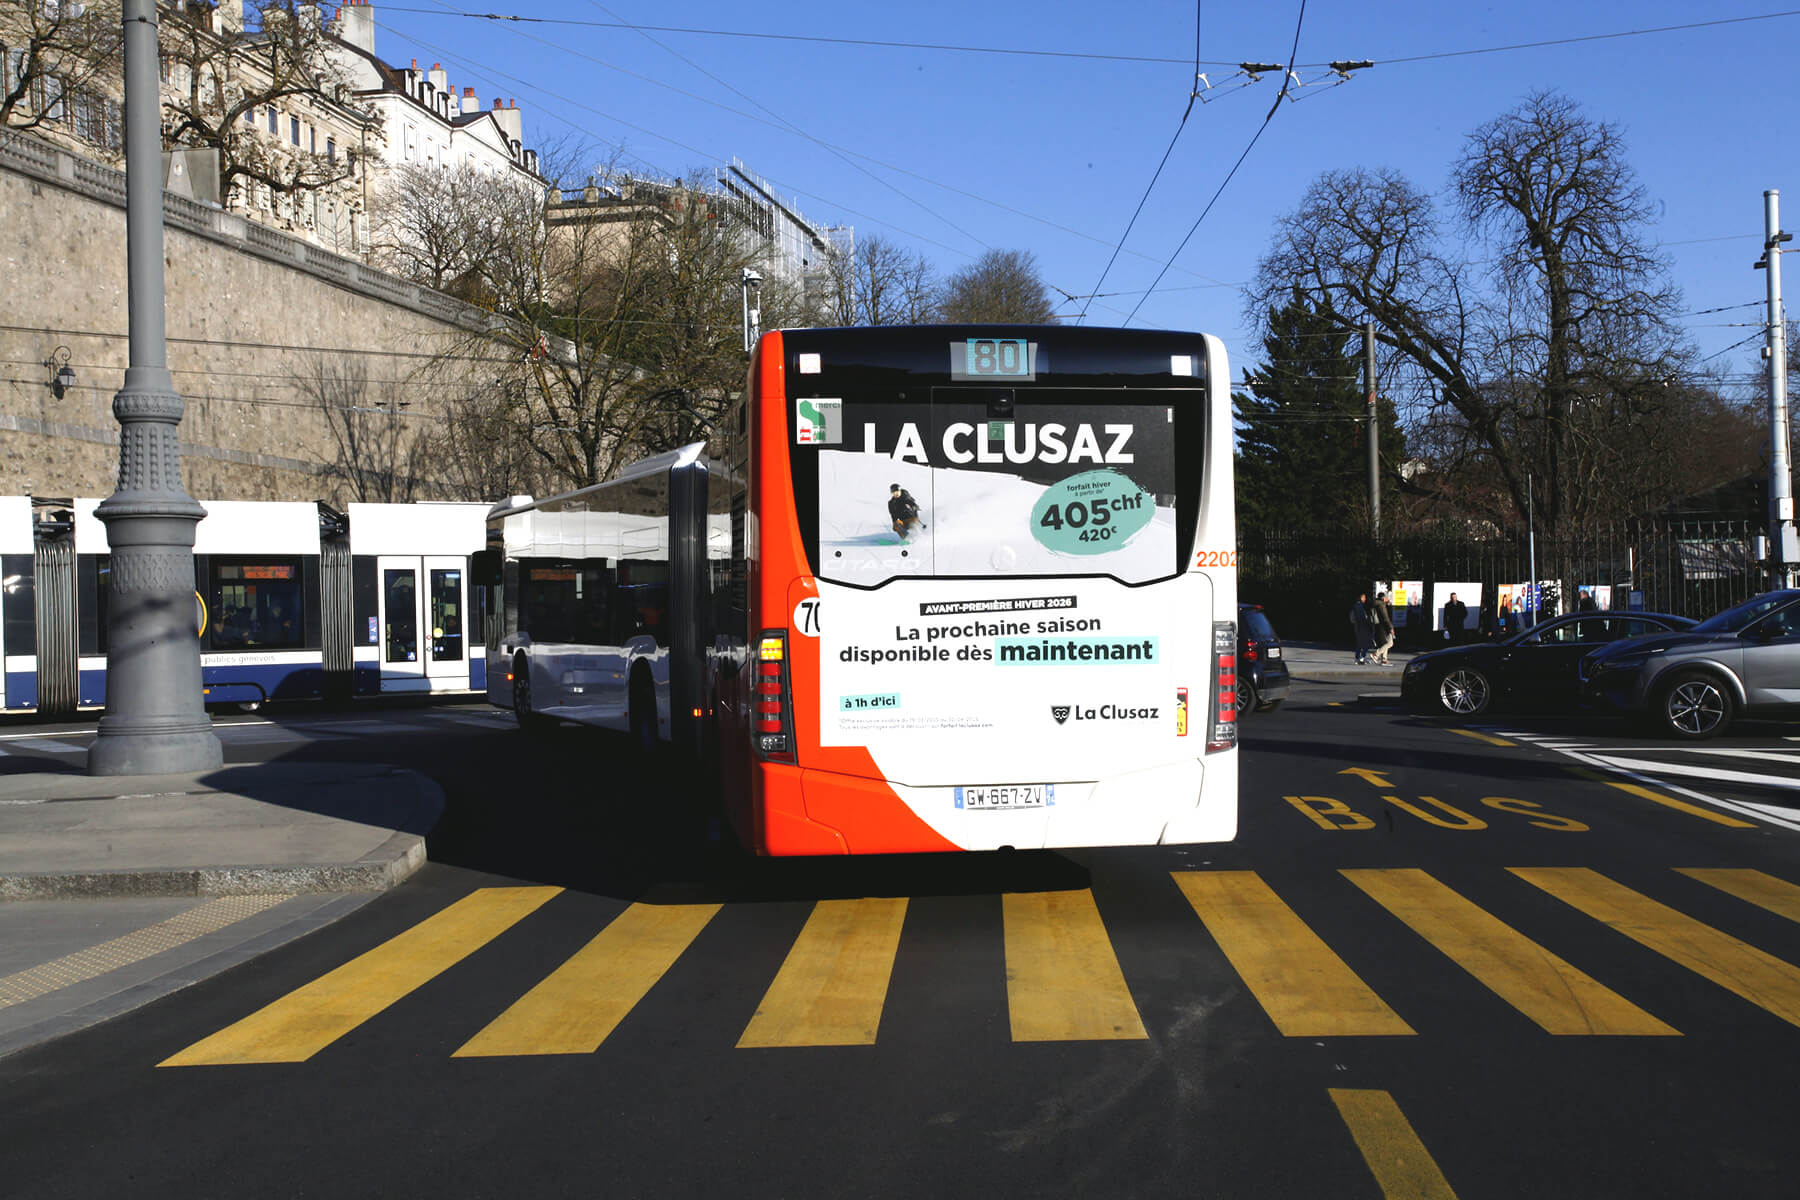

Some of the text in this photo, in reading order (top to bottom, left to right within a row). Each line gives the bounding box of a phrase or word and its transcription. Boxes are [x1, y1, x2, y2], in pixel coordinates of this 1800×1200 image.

[974, 340, 1020, 373] 80
[863, 422, 1134, 464] LA CLUSAZ
[1066, 481, 1111, 492] forfait hiver
[1078, 526, 1117, 543] 420€
[924, 598, 1073, 615] AVANT-PREMIÈRE HIVER 2026
[896, 617, 1101, 643] La prochaine saison
[839, 640, 1153, 665] disponible dès maintenant
[844, 695, 896, 709] à 1h d'ici
[1075, 703, 1159, 720] La Clusaz
[966, 788, 1042, 806] GW-667-ZV
[1282, 796, 1591, 832] BUS
